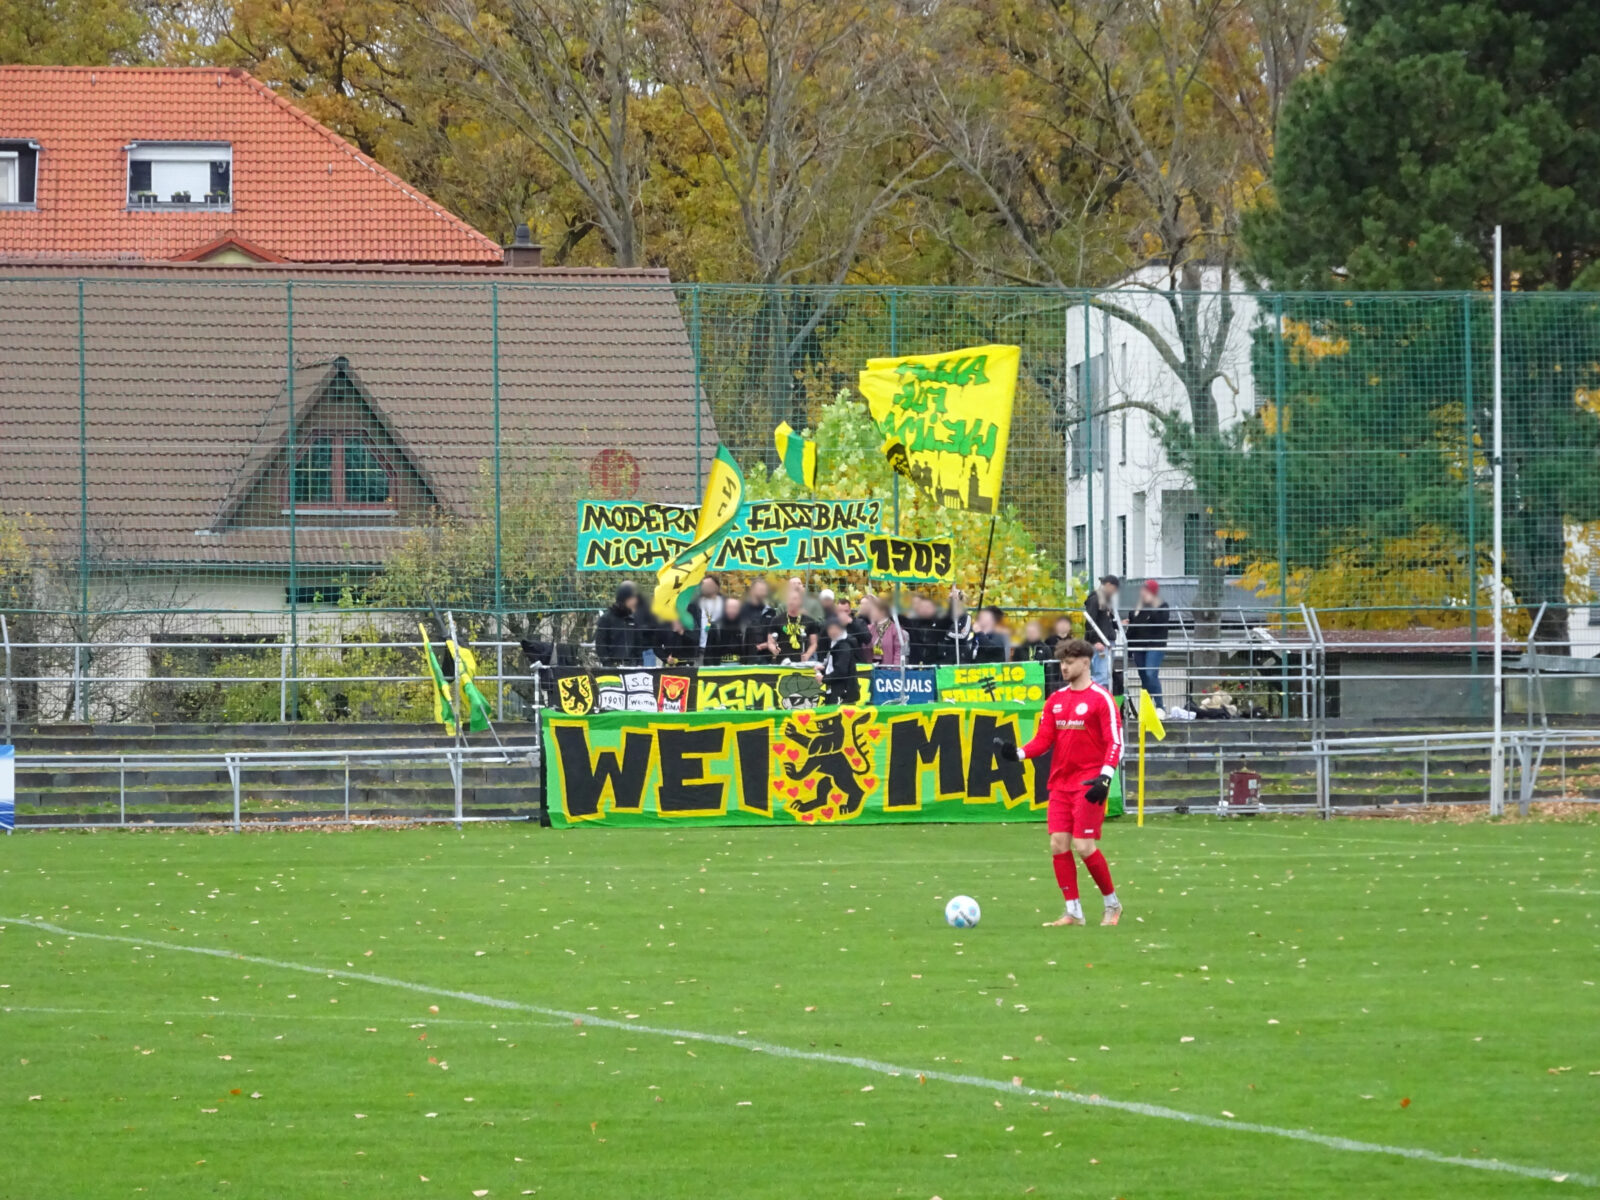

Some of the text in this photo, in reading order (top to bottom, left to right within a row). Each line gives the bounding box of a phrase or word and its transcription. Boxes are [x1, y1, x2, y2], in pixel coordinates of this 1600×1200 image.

[747, 501, 880, 532] FUSSBALL?
[796, 533, 867, 566] UNS
[869, 538, 952, 576] 1903
[697, 679, 775, 711] KSM
[875, 678, 933, 693] CASUALS
